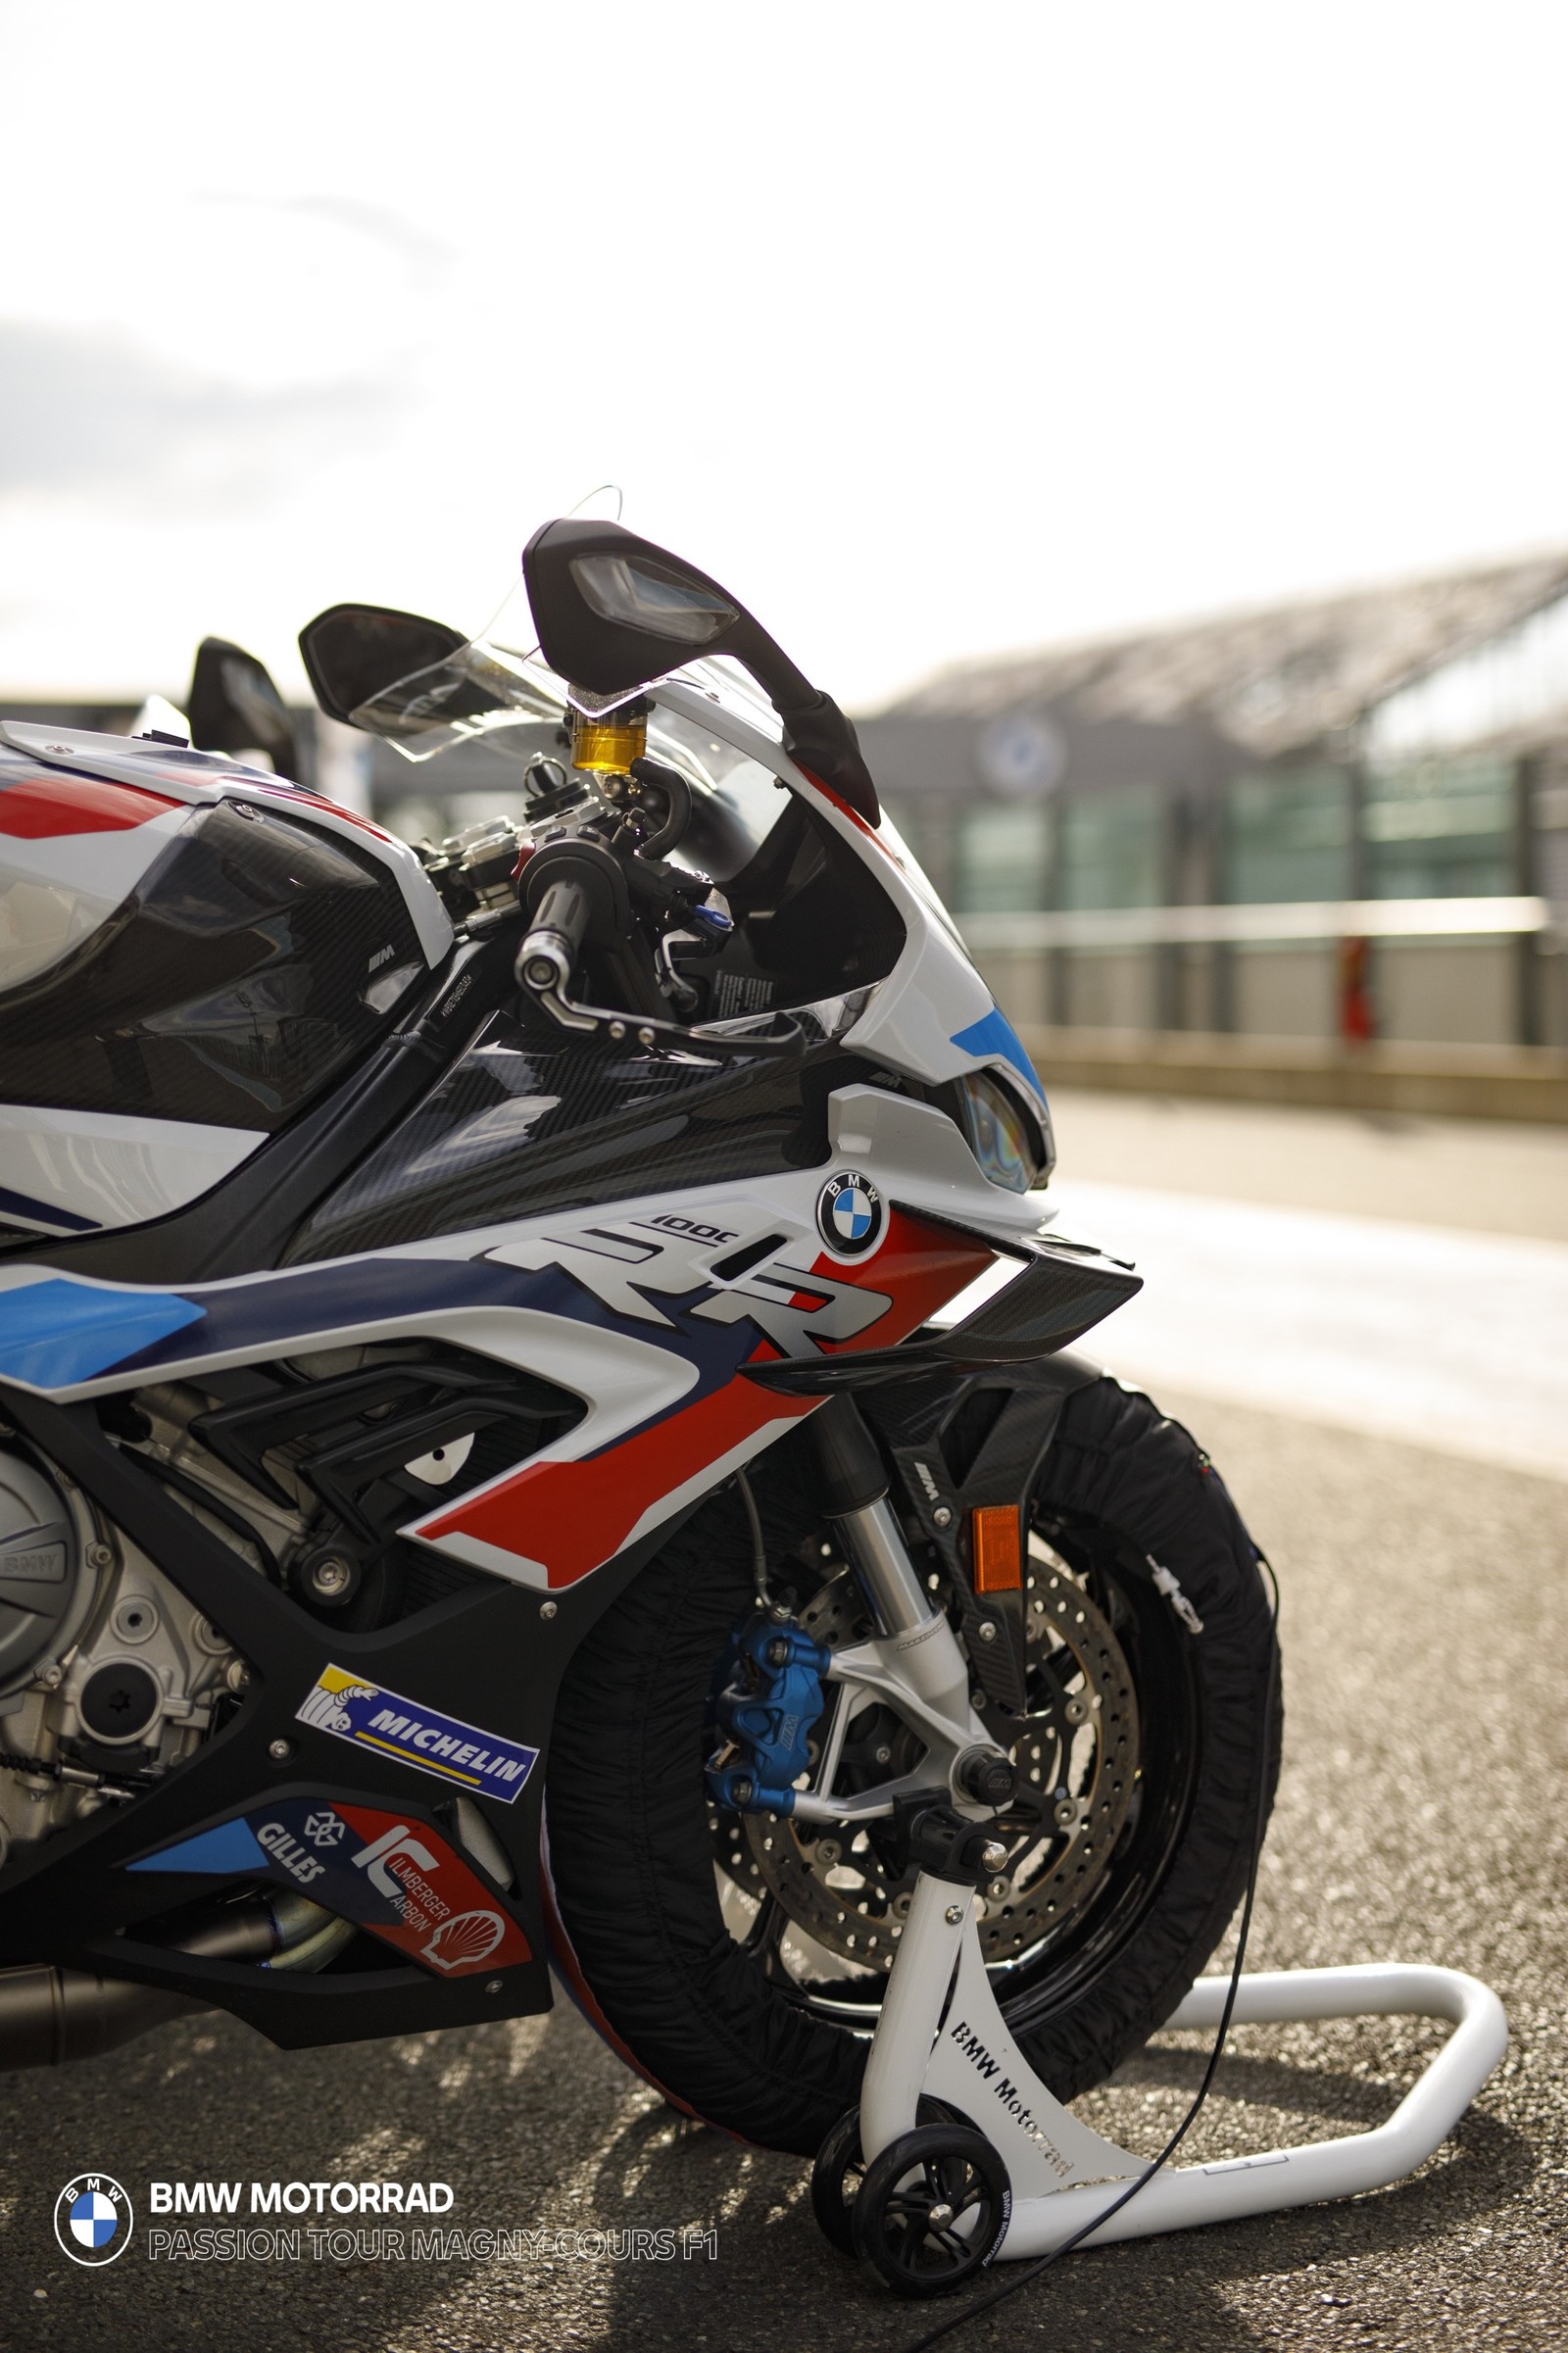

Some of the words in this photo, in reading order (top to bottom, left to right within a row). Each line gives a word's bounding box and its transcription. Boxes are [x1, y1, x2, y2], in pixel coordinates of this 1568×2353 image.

[827, 1174, 880, 1203] BMW
[4, 1554, 59, 1573] BMW
[368, 1708, 526, 1783] MICHELIN
[257, 1822, 326, 1884] GILLES
[389, 1857, 451, 1922] ILMBERGER
[951, 2021, 1002, 2080] BMW
[994, 2077, 1075, 2179] Motorrad
[1002, 2189, 1011, 2219] BMW
[981, 2221, 1009, 2268] Motorrad
